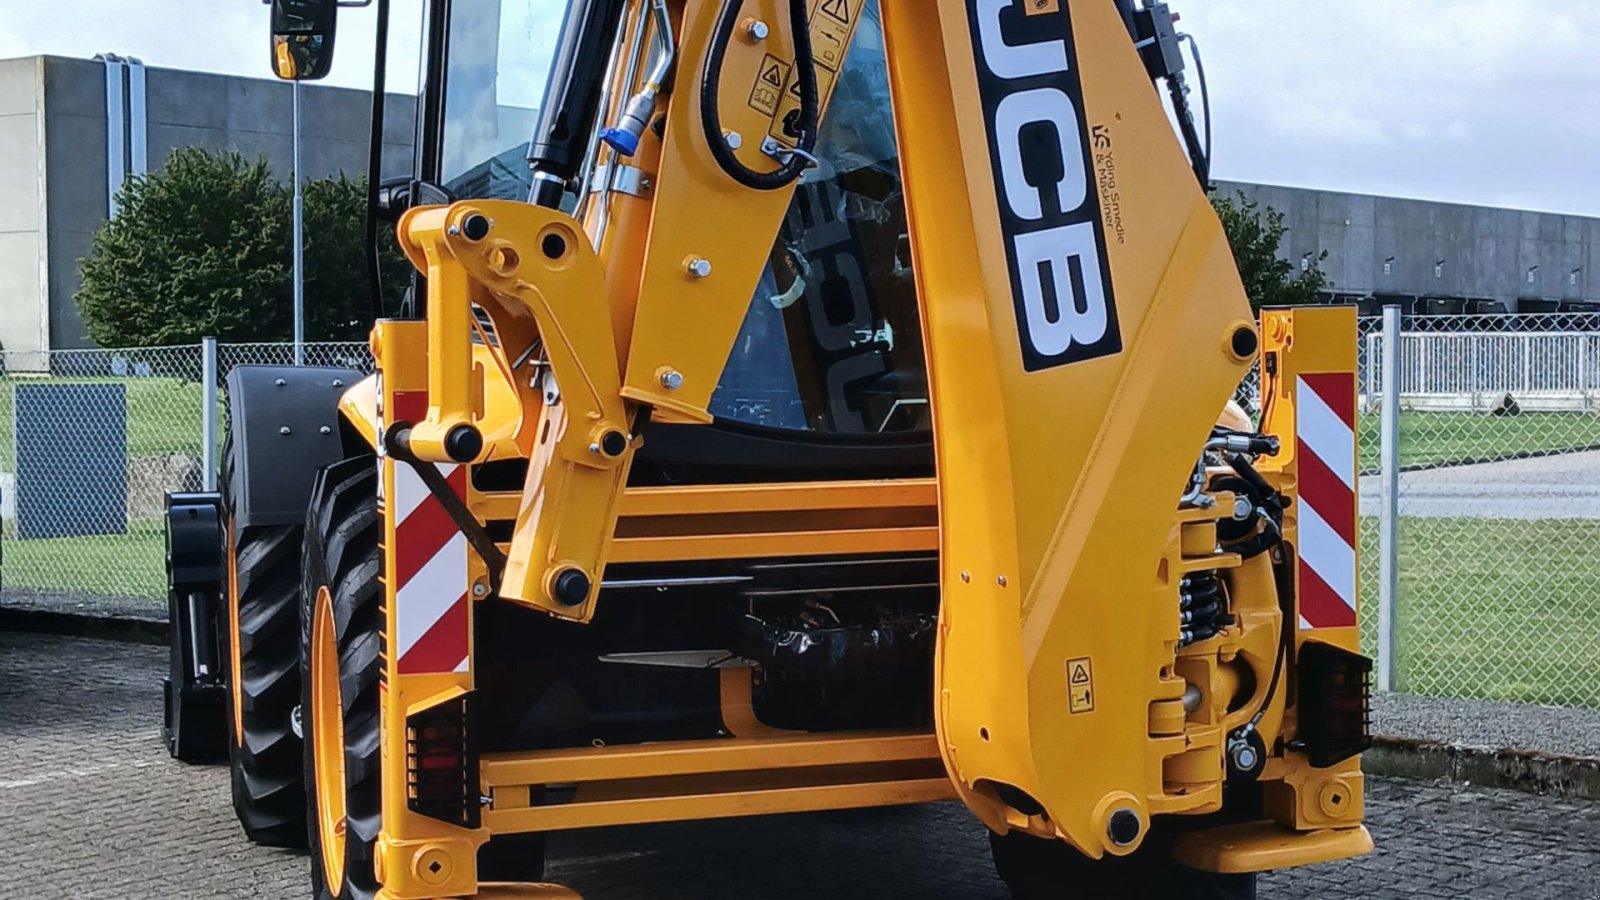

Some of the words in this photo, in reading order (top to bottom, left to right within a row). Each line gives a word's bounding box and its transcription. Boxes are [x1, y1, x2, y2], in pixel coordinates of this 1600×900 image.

[976, 0, 1107, 356] JCB
[1098, 168, 1113, 229] Maskiner
[1111, 192, 1125, 244] Smedie
